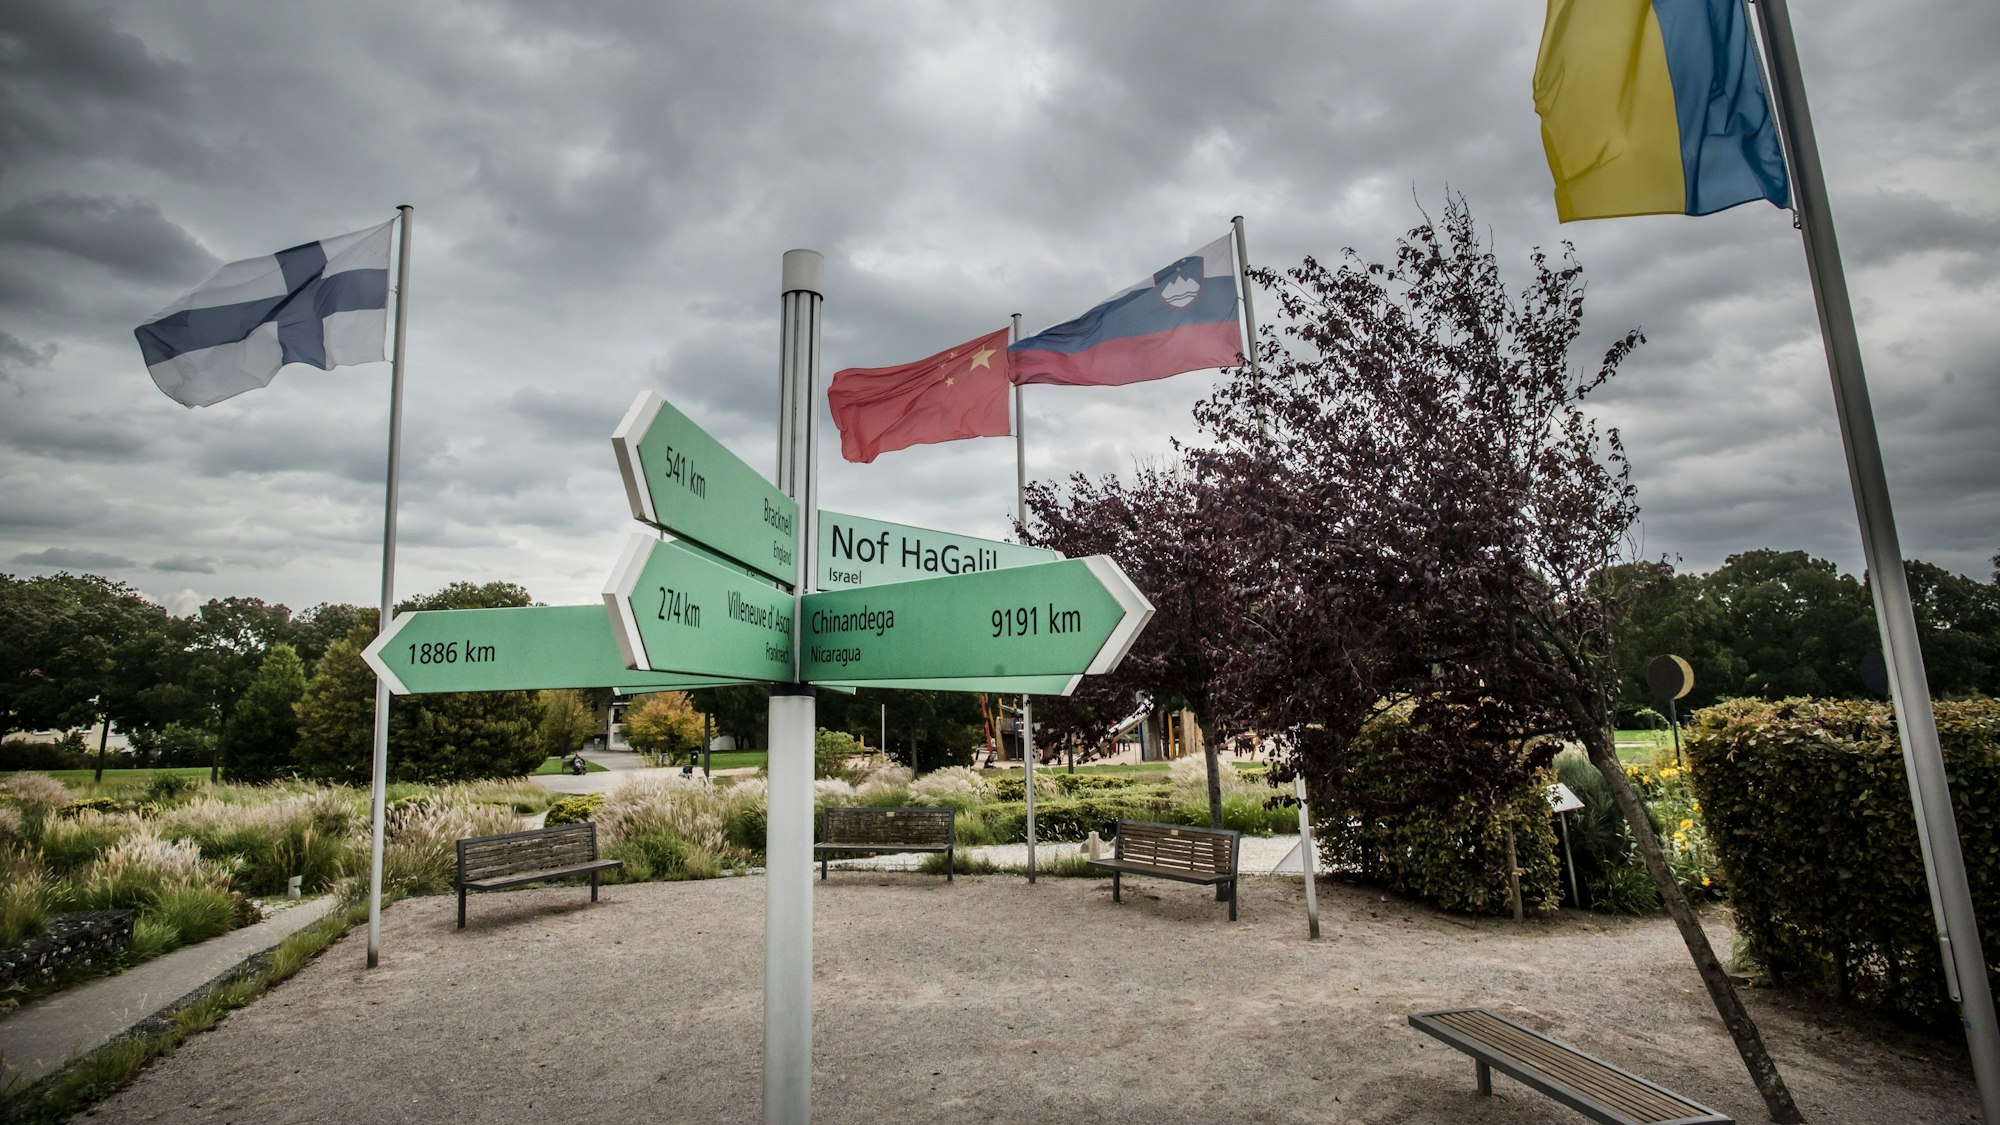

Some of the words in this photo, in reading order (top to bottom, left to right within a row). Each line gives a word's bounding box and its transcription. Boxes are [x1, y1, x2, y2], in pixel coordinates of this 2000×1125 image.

[666, 446, 685, 487] 541
[690, 460, 705, 499] km
[764, 497, 792, 538] Bracknell
[773, 540, 791, 565] England
[832, 524, 889, 565] Nof
[902, 537, 997, 575] HaGalil
[829, 567, 862, 584] Israel
[658, 587, 681, 624] 274
[684, 592, 700, 629] km
[727, 589, 767, 628] Villeneuve
[812, 604, 894, 637] Chinandega
[992, 606, 1037, 638] 9191
[1049, 603, 1080, 634] km
[408, 641, 458, 665] 1886
[465, 640, 496, 663] km
[765, 642, 790, 664] Frankreich
[810, 645, 861, 667] Nicaragua
